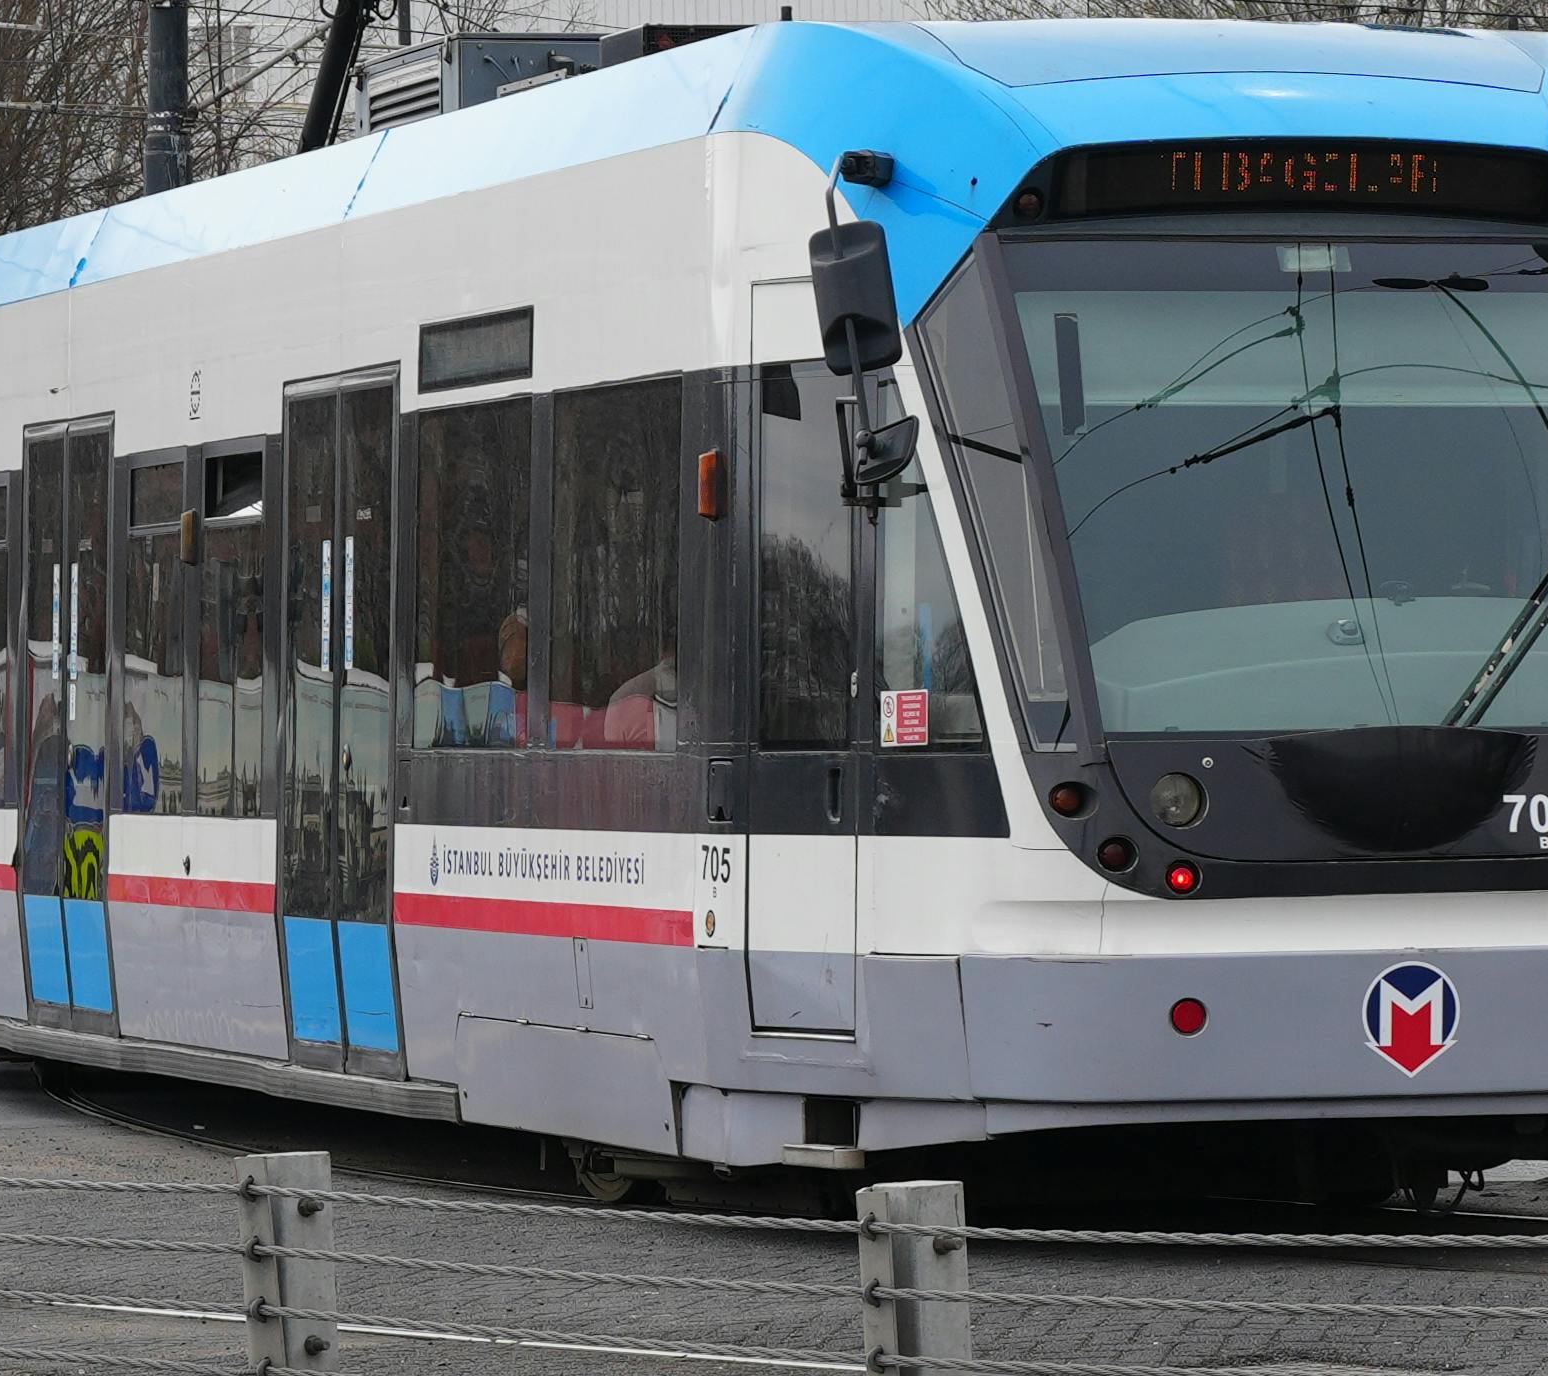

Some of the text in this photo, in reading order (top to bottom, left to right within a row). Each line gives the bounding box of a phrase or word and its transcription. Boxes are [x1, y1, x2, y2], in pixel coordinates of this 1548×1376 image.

[443, 844, 645, 885] İSTANBUL BÜYÜKŞEHİR BELEDİYESİ
[702, 845, 731, 883] 705
